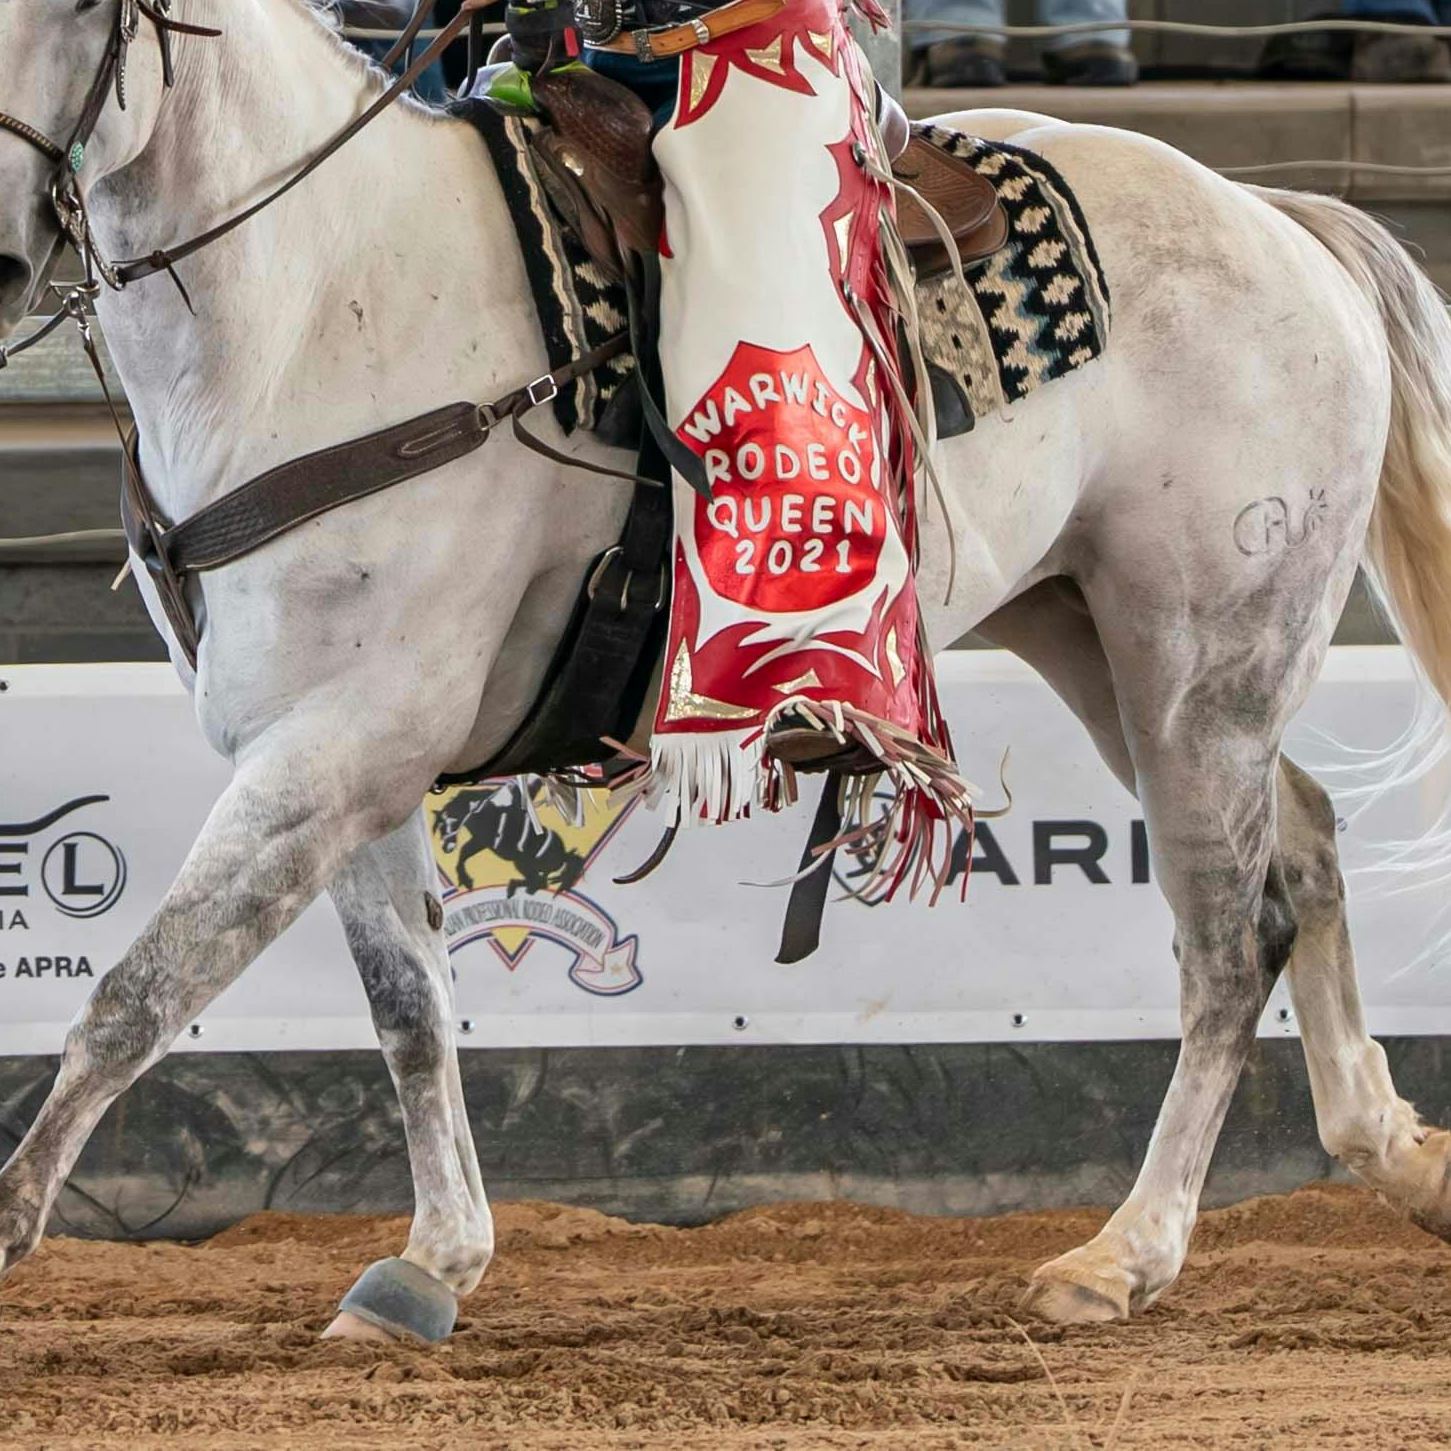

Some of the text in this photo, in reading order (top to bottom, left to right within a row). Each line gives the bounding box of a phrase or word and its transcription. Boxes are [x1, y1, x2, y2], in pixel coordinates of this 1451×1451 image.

[683, 370, 868, 454] WARWICK
[705, 442, 862, 486] RODEO
[707, 494, 874, 537] QUEEN
[735, 538, 853, 575] 2021
[15, 955, 95, 978] APRA
